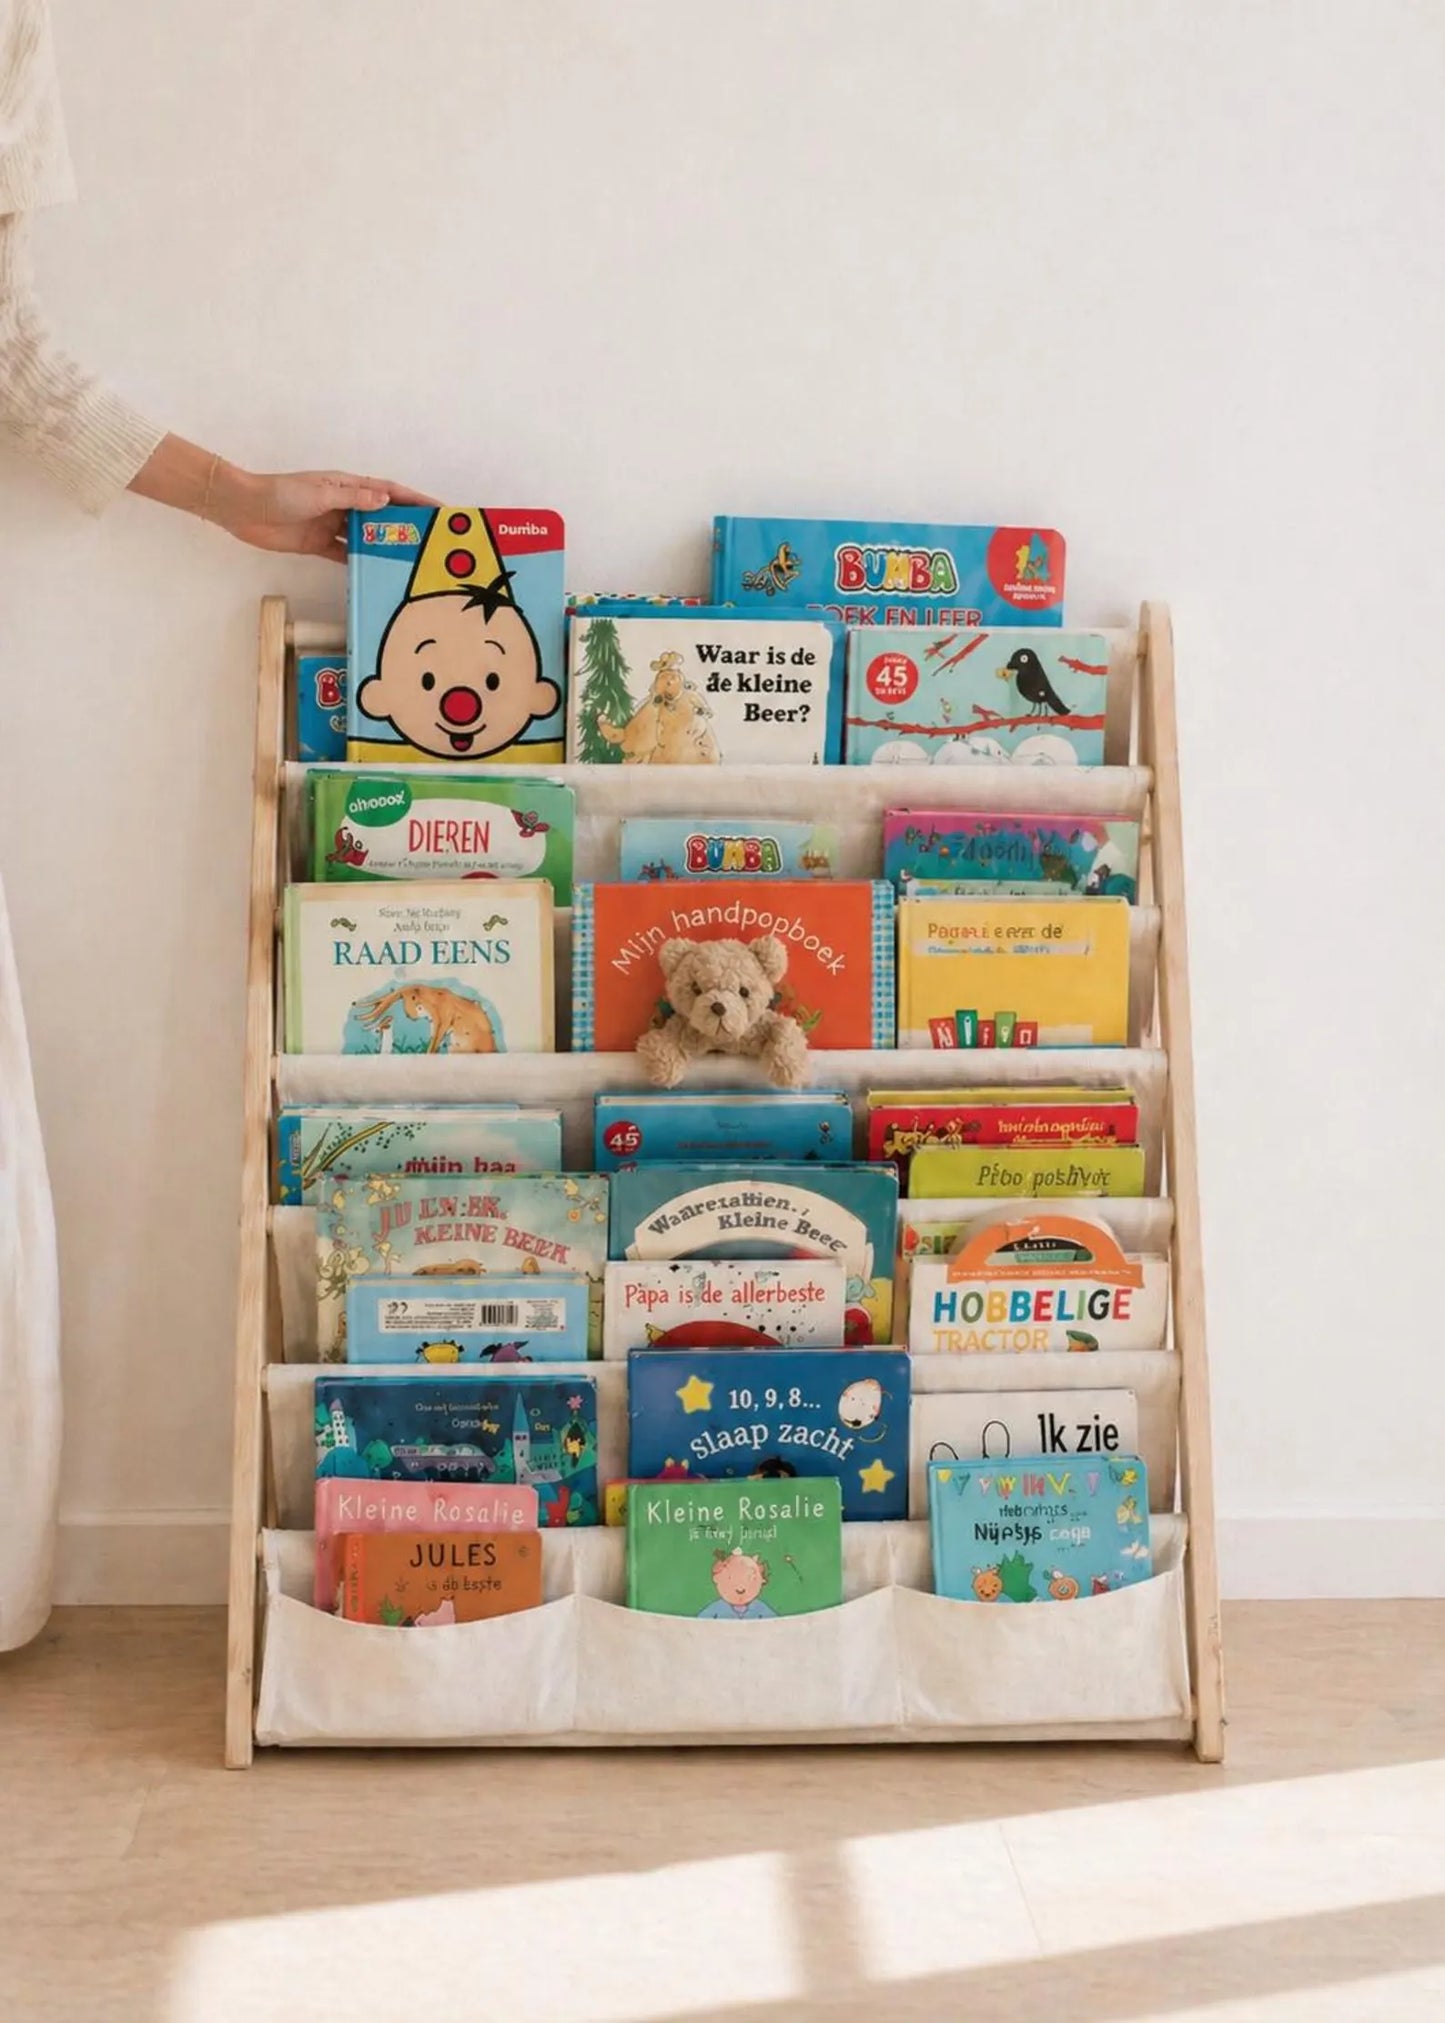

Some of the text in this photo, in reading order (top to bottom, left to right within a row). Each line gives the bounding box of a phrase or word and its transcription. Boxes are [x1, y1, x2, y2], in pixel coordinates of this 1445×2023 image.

[836, 544, 958, 595] BUMBA
[695, 644, 817, 665] Waar is de
[737, 673, 812, 693] kleine
[876, 665, 908, 687] 45
[744, 703, 810, 723] Beer?
[408, 819, 490, 853] DIEREN
[686, 835, 783, 874] BUMBA
[611, 900, 846, 976] Mijn handpopboek
[333, 939, 511, 966] RAAD EENS
[609, 1126, 639, 1147] 45
[717, 1211, 789, 1231] Kleine
[679, 1285, 694, 1304] is
[701, 1280, 723, 1304] de
[731, 1279, 826, 1304] allerbeste
[933, 1288, 1133, 1324] HOBBELIGE
[933, 1328, 1049, 1351] TRACTOR
[729, 1387, 821, 1412] 10, 9, 8...
[690, 1423, 855, 1461] Slaap zacht
[1076, 1414, 1119, 1452] zie
[338, 1495, 525, 1524] Kleine Rosalie
[647, 1495, 825, 1524] Kleine Rosalie
[409, 1543, 497, 1568] JULES
